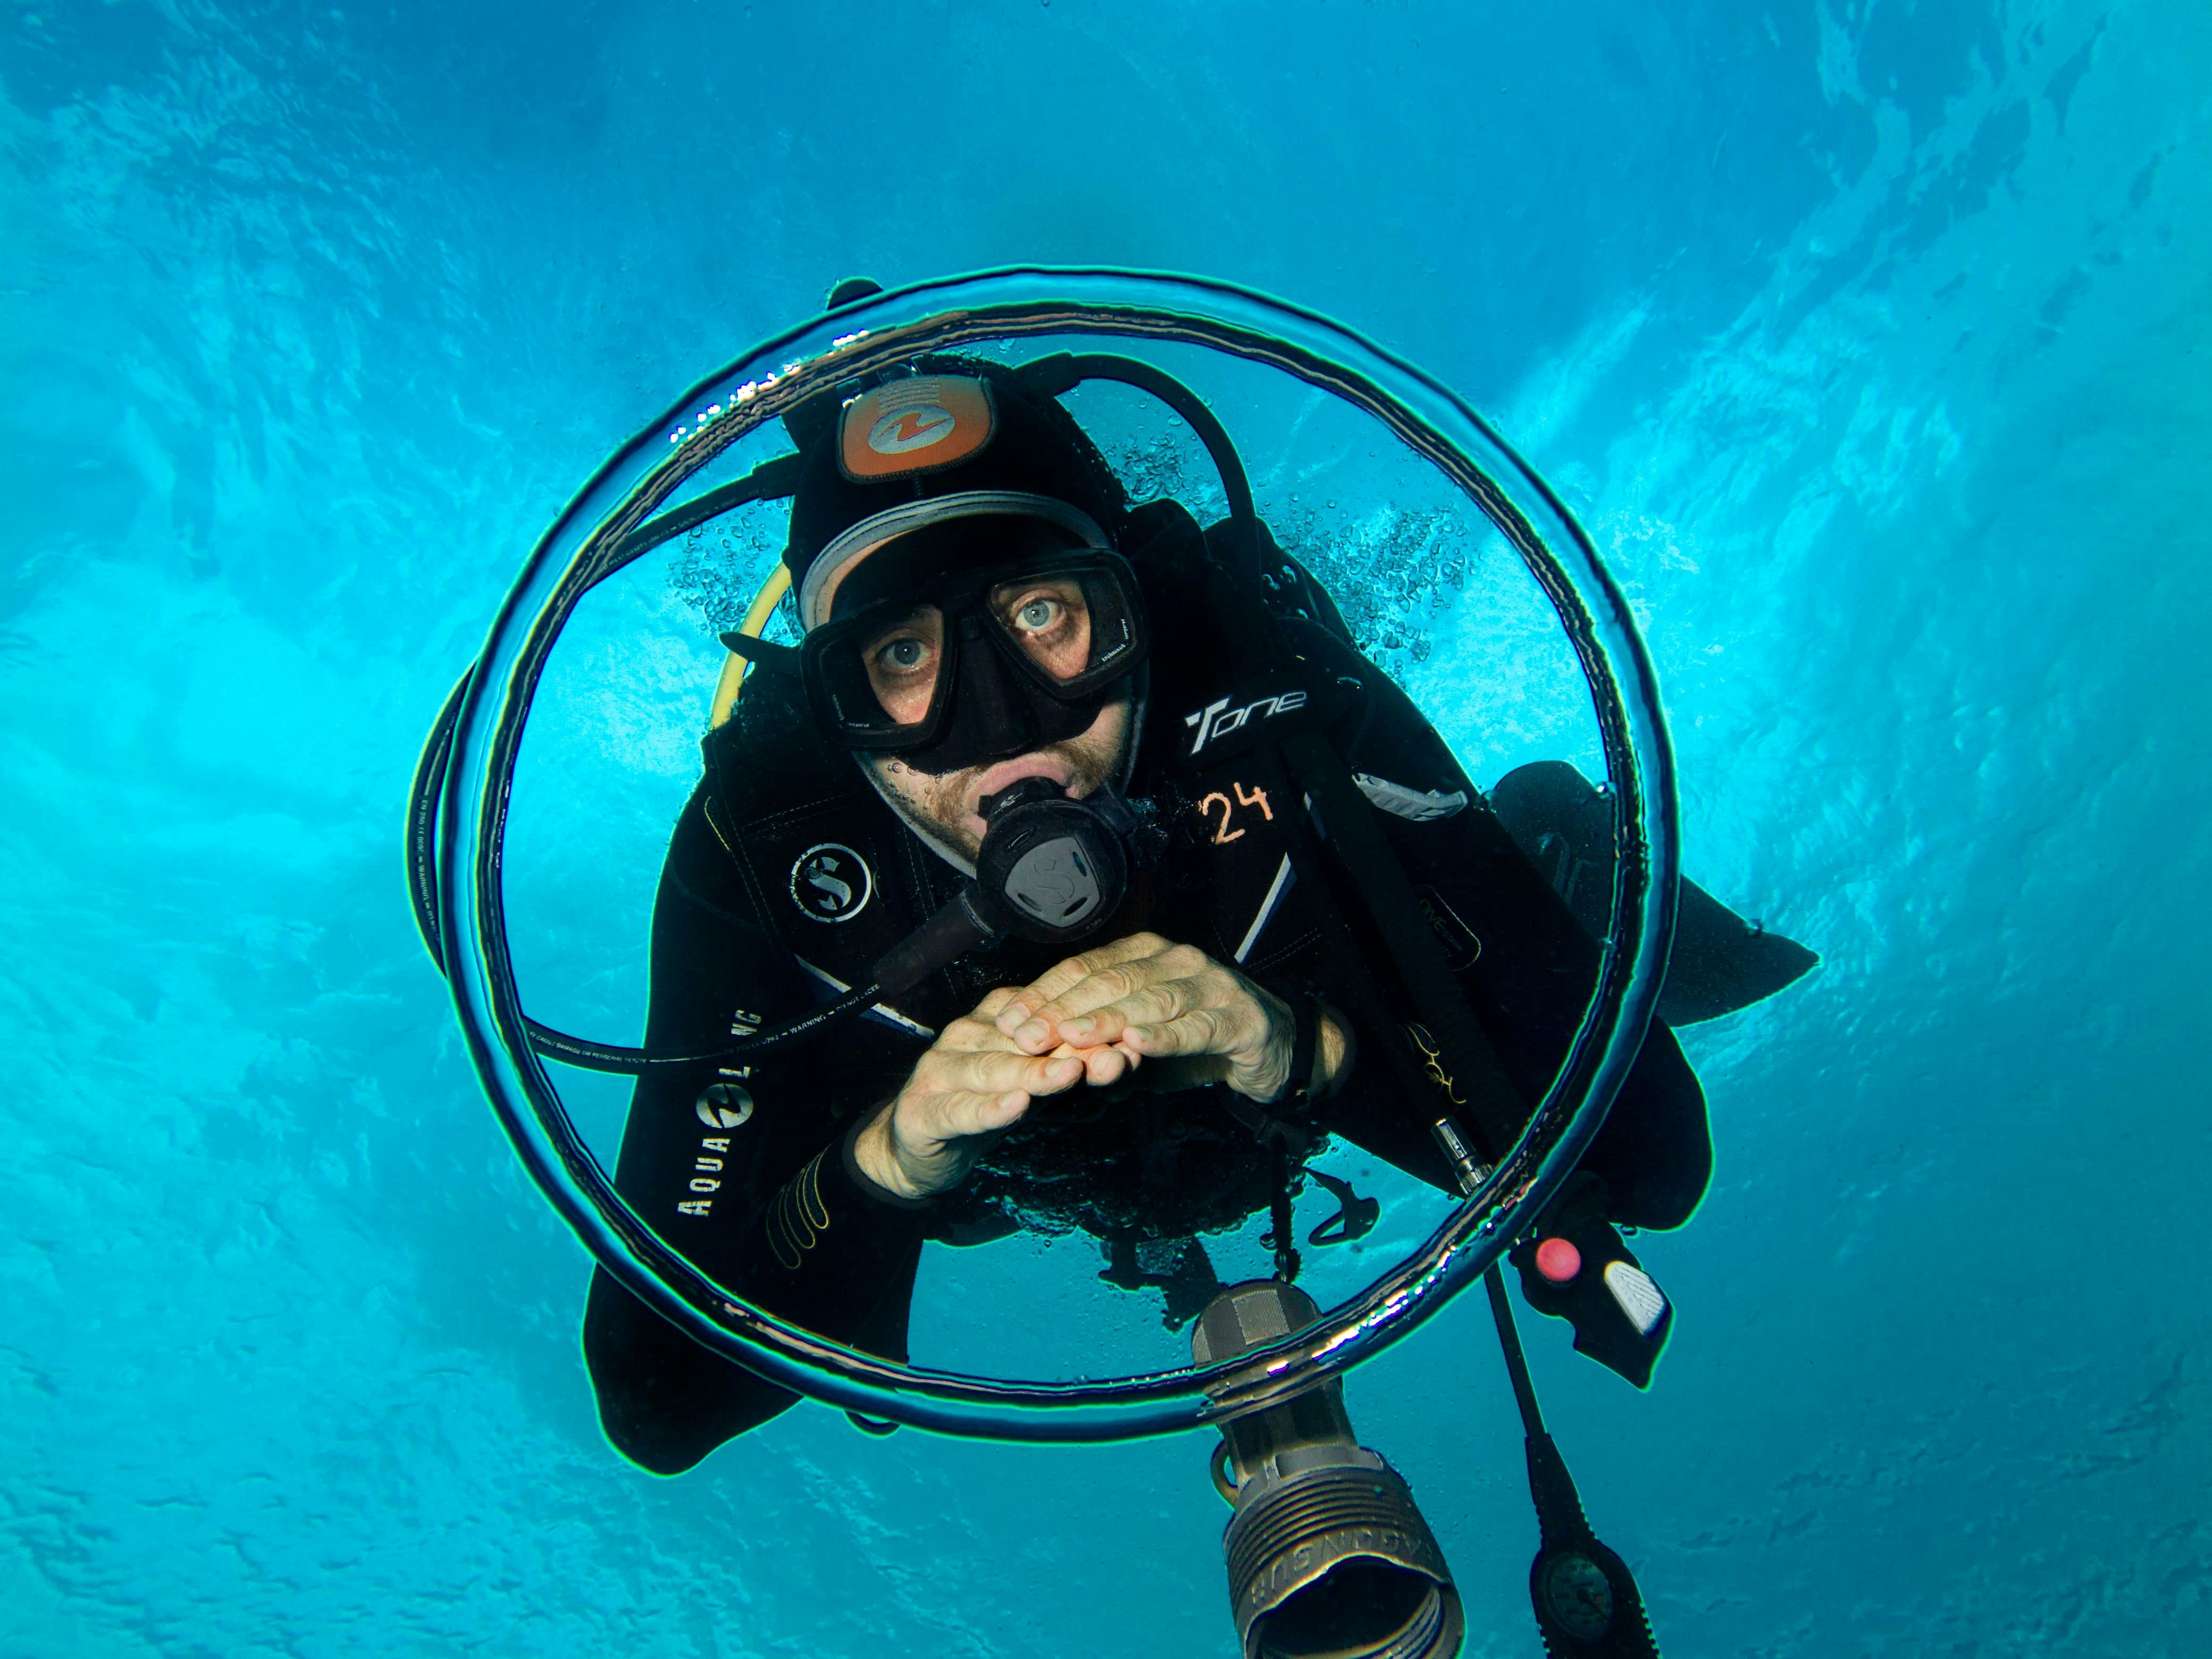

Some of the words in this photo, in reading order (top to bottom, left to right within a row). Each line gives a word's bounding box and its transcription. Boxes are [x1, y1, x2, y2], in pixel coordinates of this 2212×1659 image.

[1201, 782, 1273, 845] 24
[789, 1013, 826, 1034] WARNING
[677, 1137, 731, 1217] AQUA
